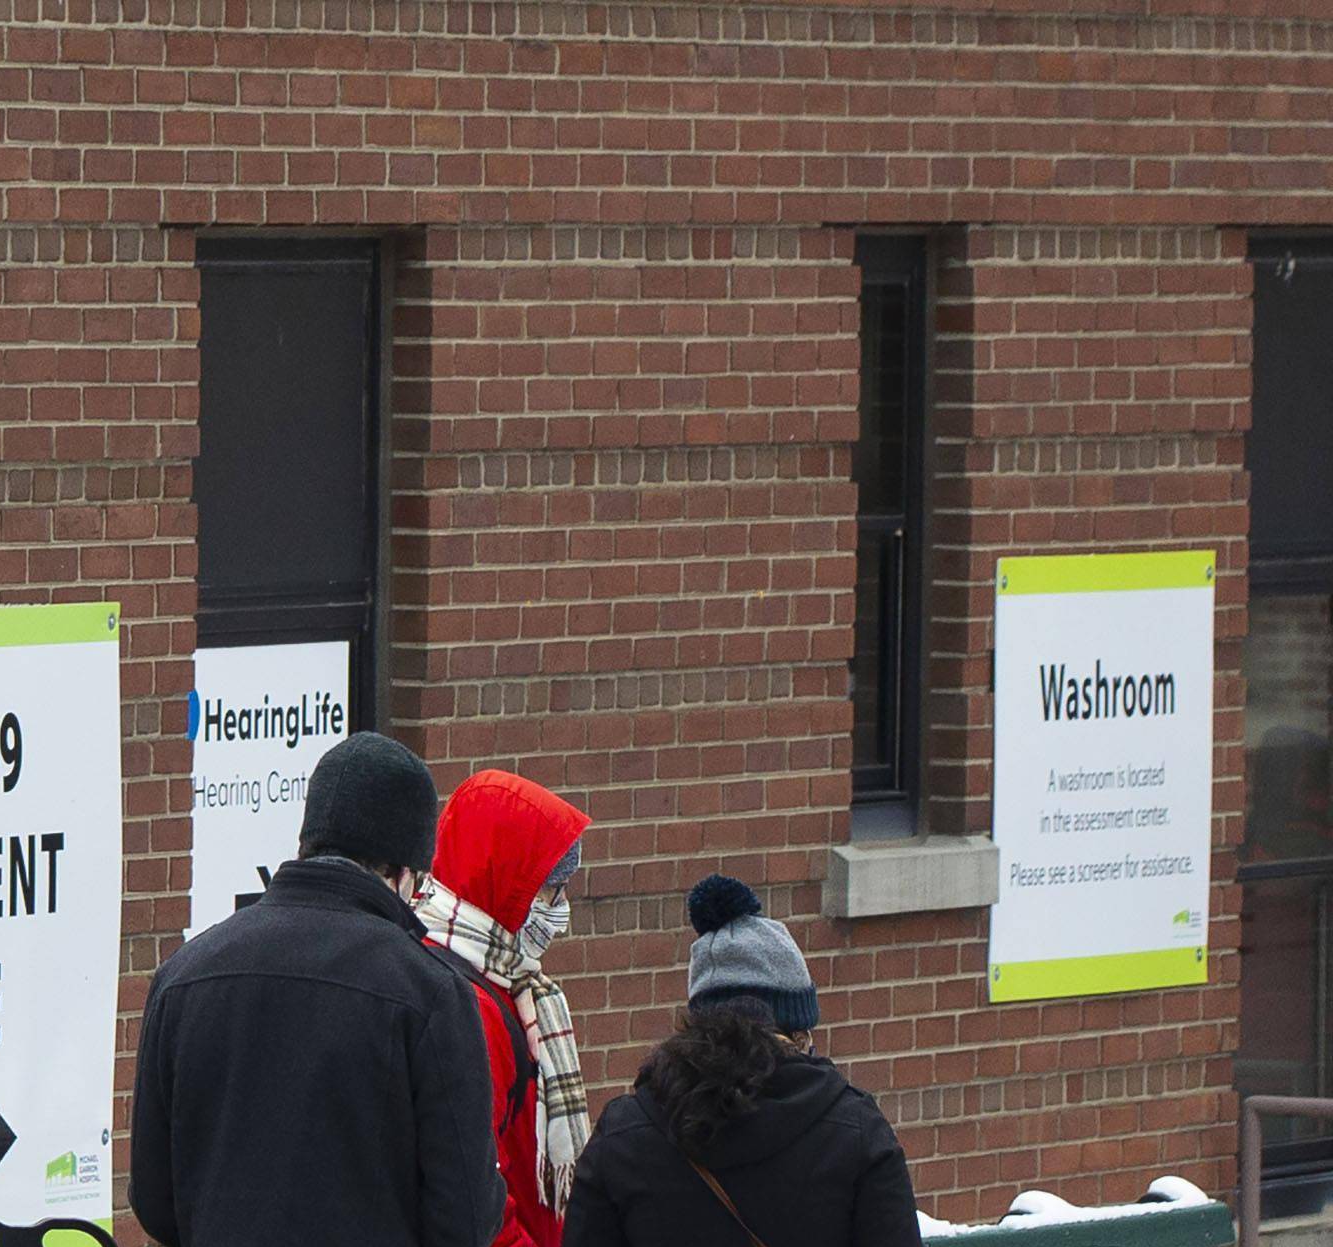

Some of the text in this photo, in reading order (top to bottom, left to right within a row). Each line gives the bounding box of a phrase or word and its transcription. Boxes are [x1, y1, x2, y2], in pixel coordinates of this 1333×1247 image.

[1040, 659, 1175, 722] Washroom
[205, 691, 344, 749] HearingLife
[193, 770, 306, 813] Hearing Cent
[1048, 761, 1164, 792] A washroom is located
[1040, 810, 1050, 833] in
[1053, 808, 1070, 833] the
[1074, 806, 1133, 832] assessment
[1011, 861, 1045, 888] Please
[1048, 865, 1066, 885] see
[1069, 865, 1076, 883] a
[1078, 862, 1123, 882] screener
[1125, 853, 1138, 878] for
